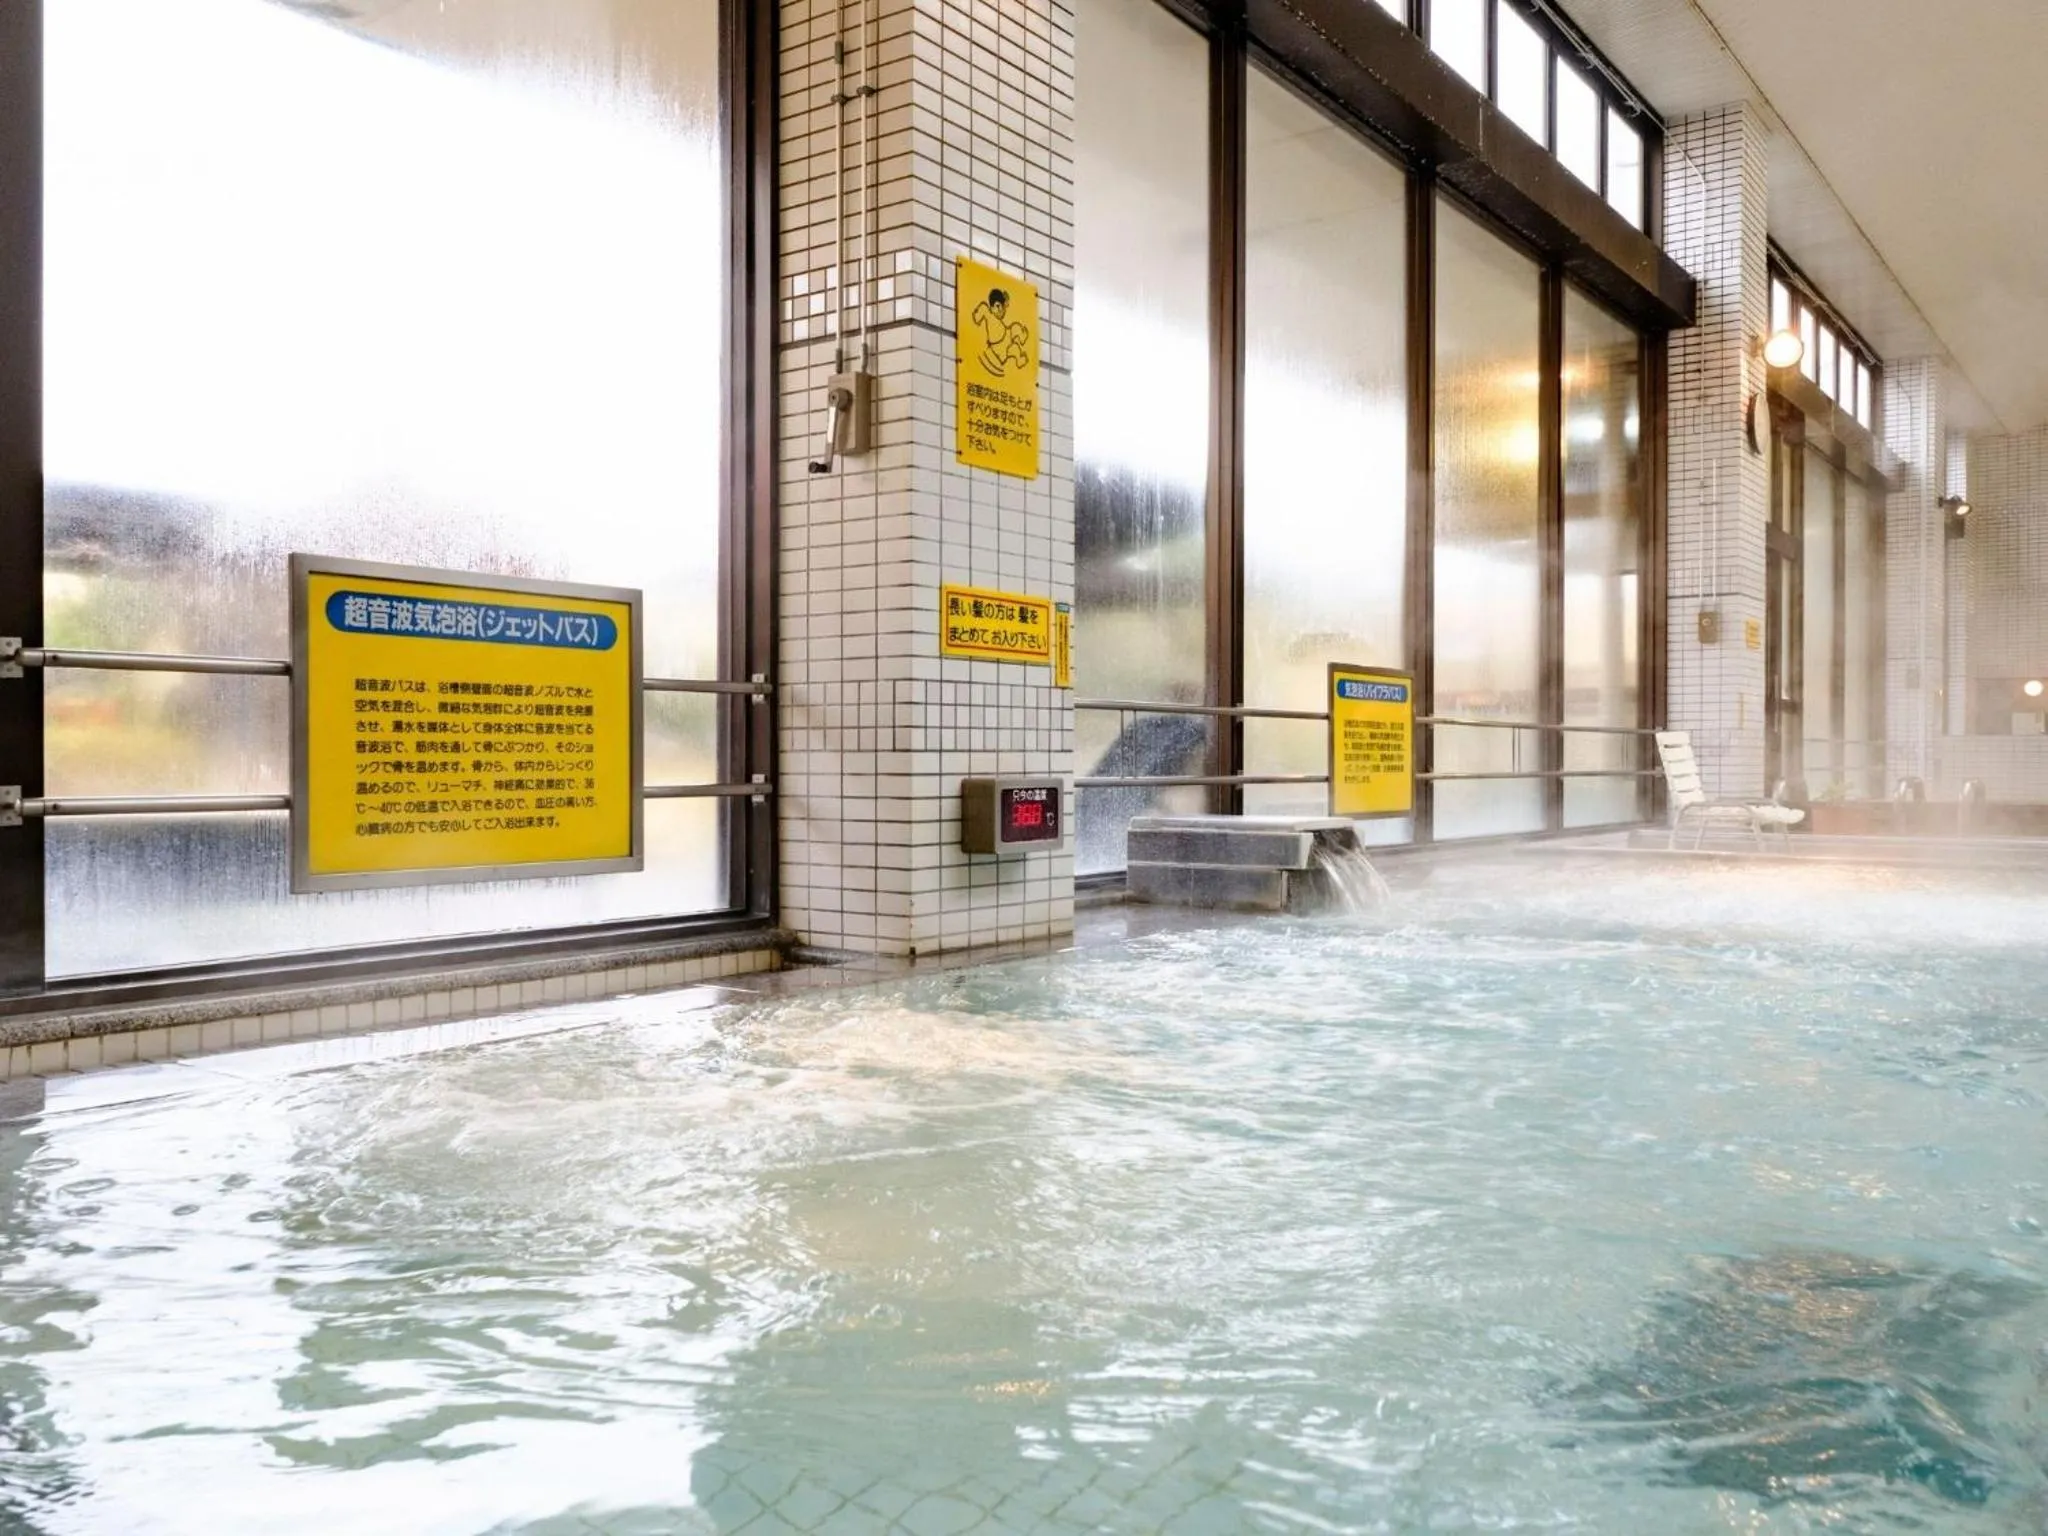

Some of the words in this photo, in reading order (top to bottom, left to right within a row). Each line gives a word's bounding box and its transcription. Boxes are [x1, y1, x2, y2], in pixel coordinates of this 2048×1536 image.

[966, 435, 997, 455] 下さい。
[344, 595, 599, 646] 超音波気泡浴(ジェットバス)
